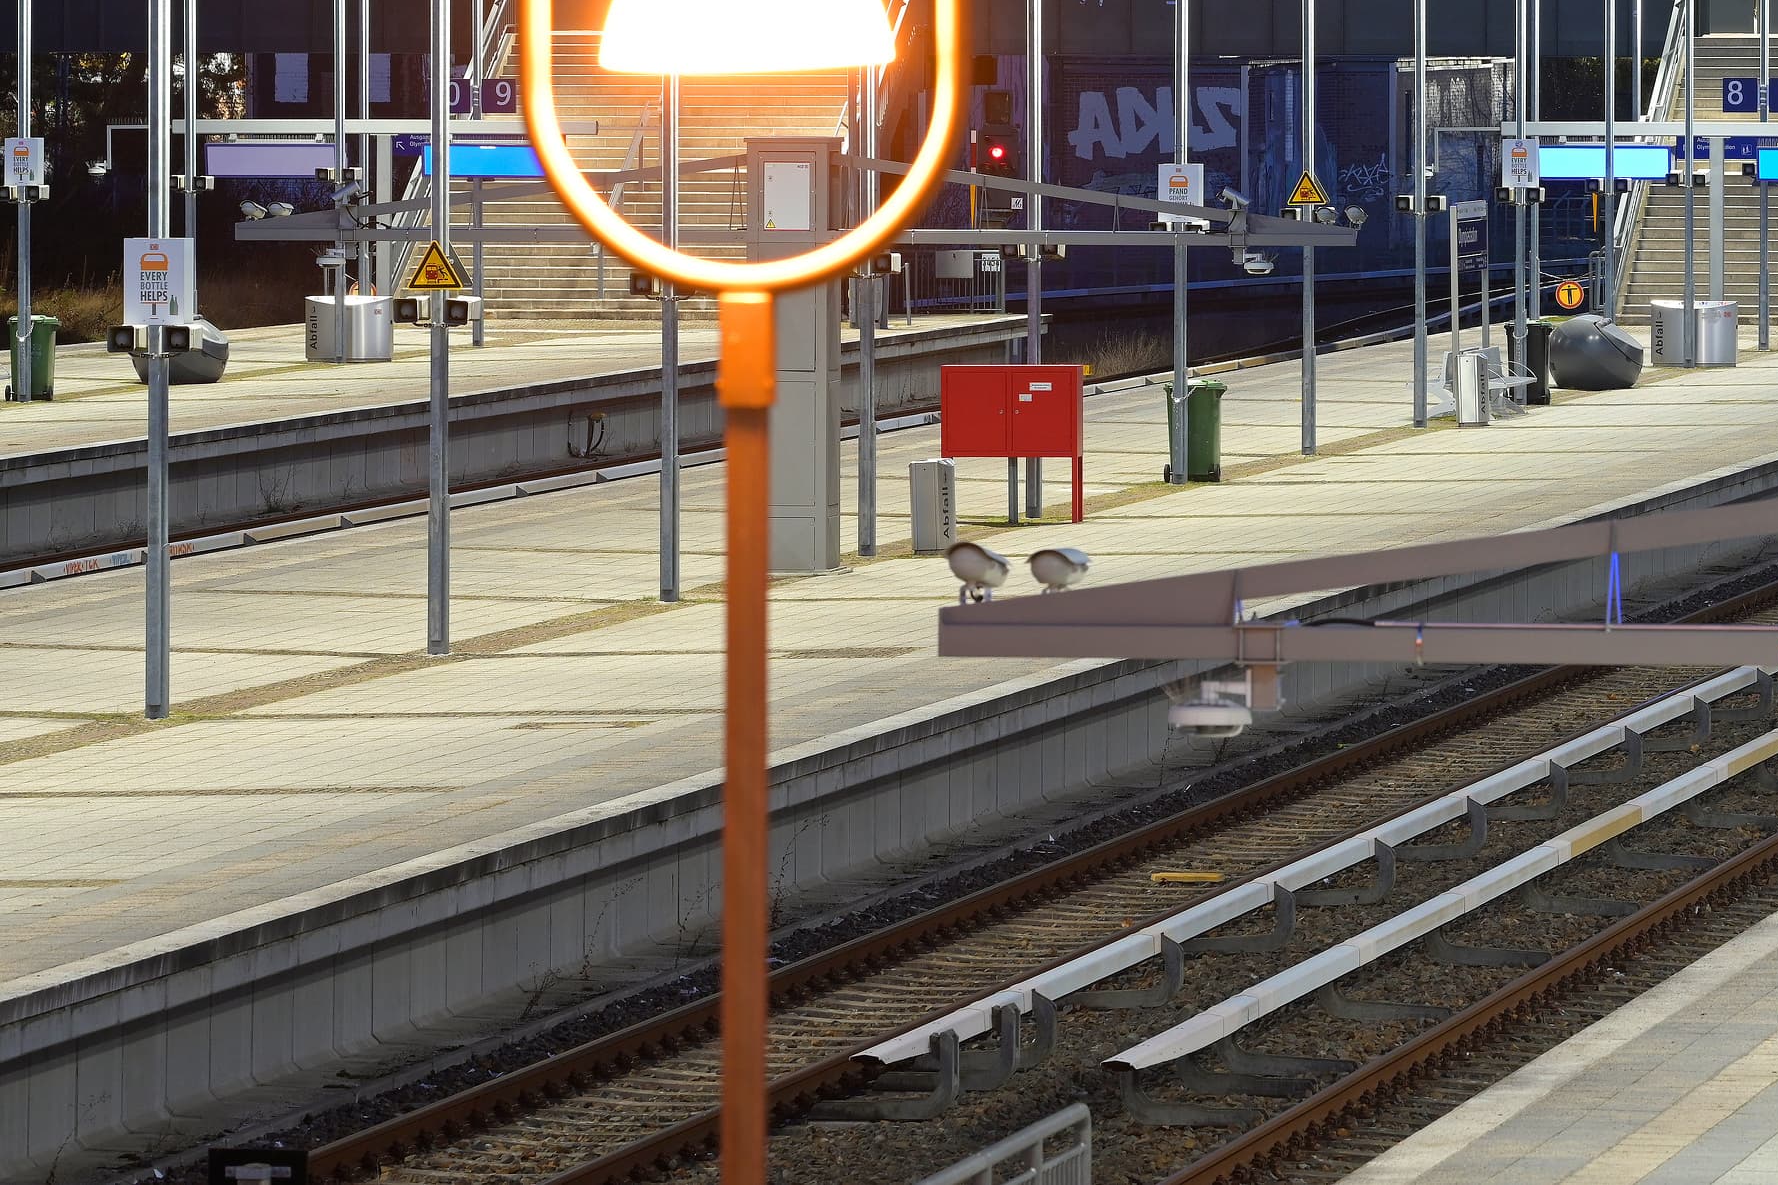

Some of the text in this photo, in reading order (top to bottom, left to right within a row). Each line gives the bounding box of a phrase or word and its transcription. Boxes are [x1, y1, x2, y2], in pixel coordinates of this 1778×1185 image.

[495, 81, 512, 106] 9
[1727, 80, 1744, 105] 8
[140, 271, 168, 281] EVERY
[140, 282, 168, 290] BOTTLE
[140, 291, 168, 301] HELPS
[309, 315, 318, 350] Abfall
[942, 486, 950, 539] Abfall
